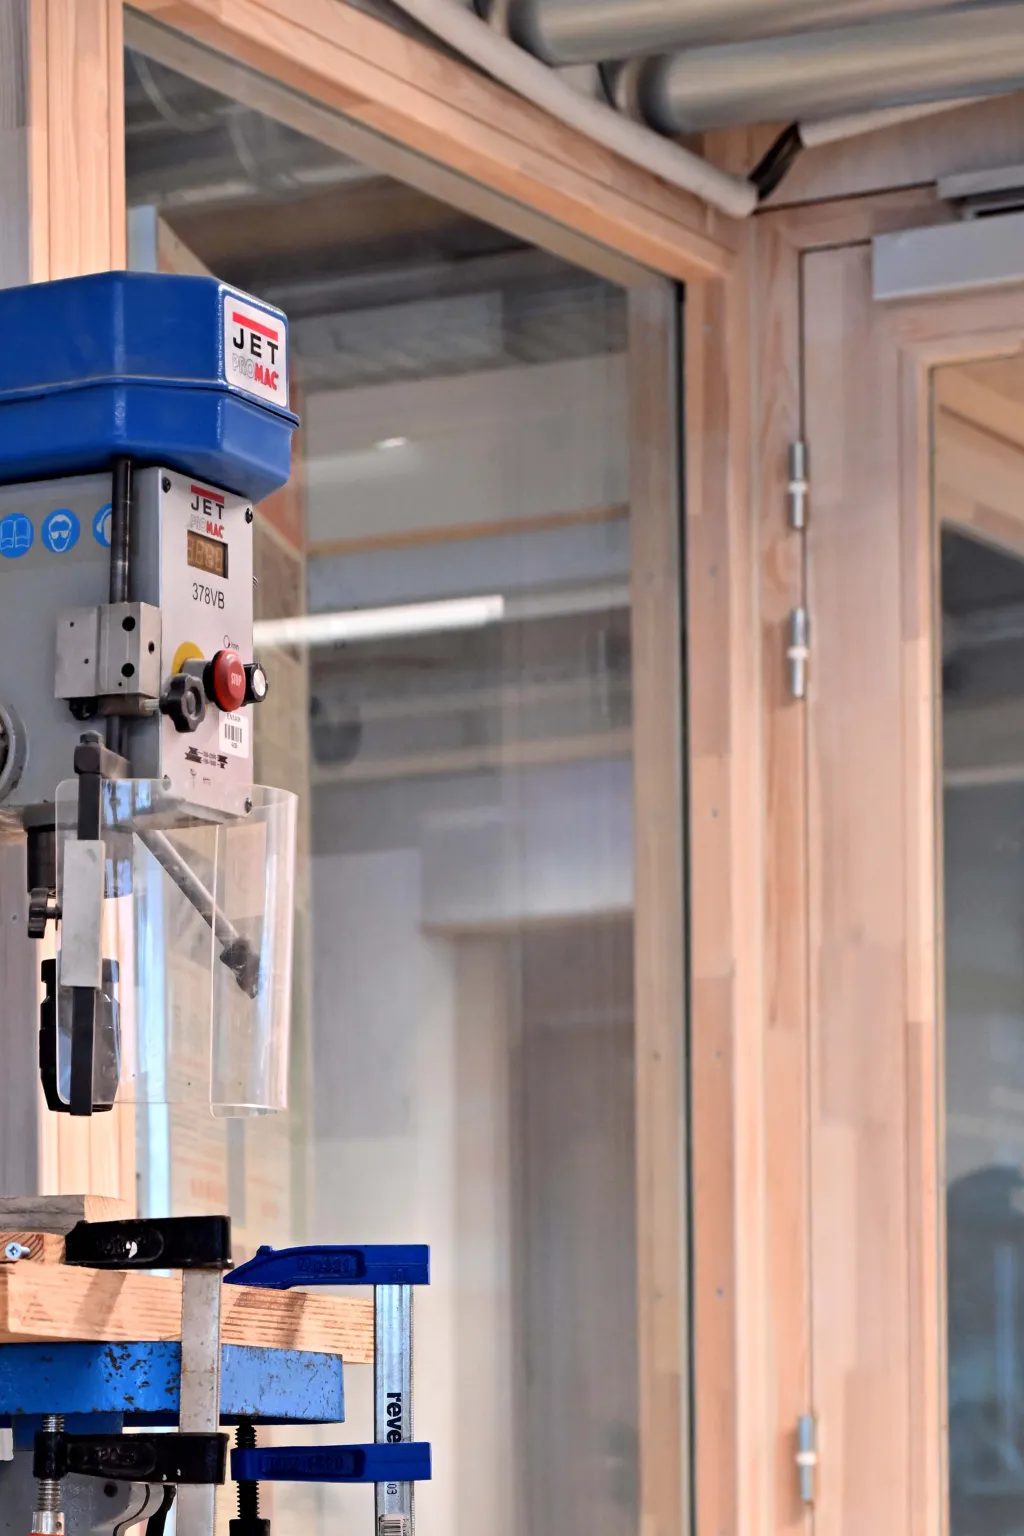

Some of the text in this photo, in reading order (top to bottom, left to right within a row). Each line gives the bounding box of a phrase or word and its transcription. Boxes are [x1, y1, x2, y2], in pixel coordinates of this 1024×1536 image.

[232, 328, 278, 365] JET
[232, 353, 278, 390] PROMAC
[191, 496, 224, 519] JET
[192, 582, 225, 609] 378VB
